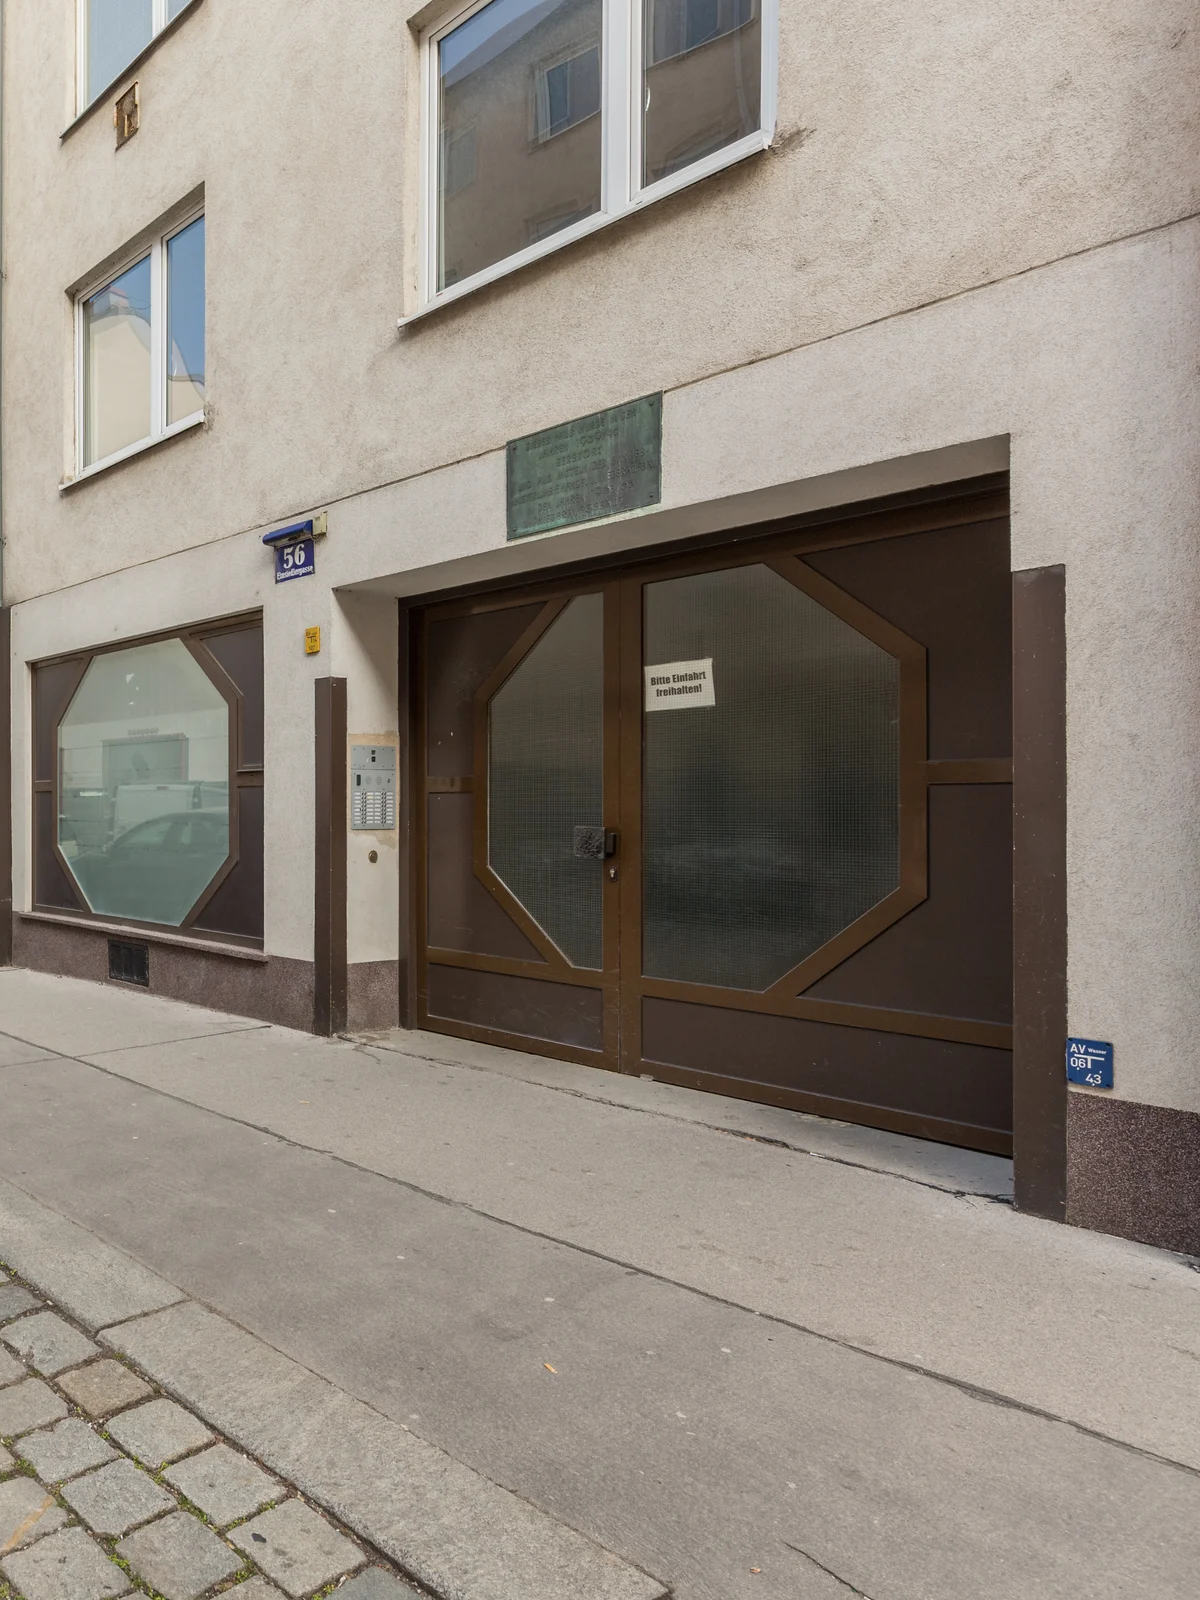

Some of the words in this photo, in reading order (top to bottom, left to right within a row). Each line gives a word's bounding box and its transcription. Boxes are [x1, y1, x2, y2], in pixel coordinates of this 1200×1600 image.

[283, 544, 305, 569] 56
[651, 676, 671, 686] Bitte
[672, 671, 706, 683] Einfahrt
[656, 684, 702, 697] freihalten!
[1070, 1043, 1086, 1054] AV
[1087, 1047, 1107, 1055] Wasser
